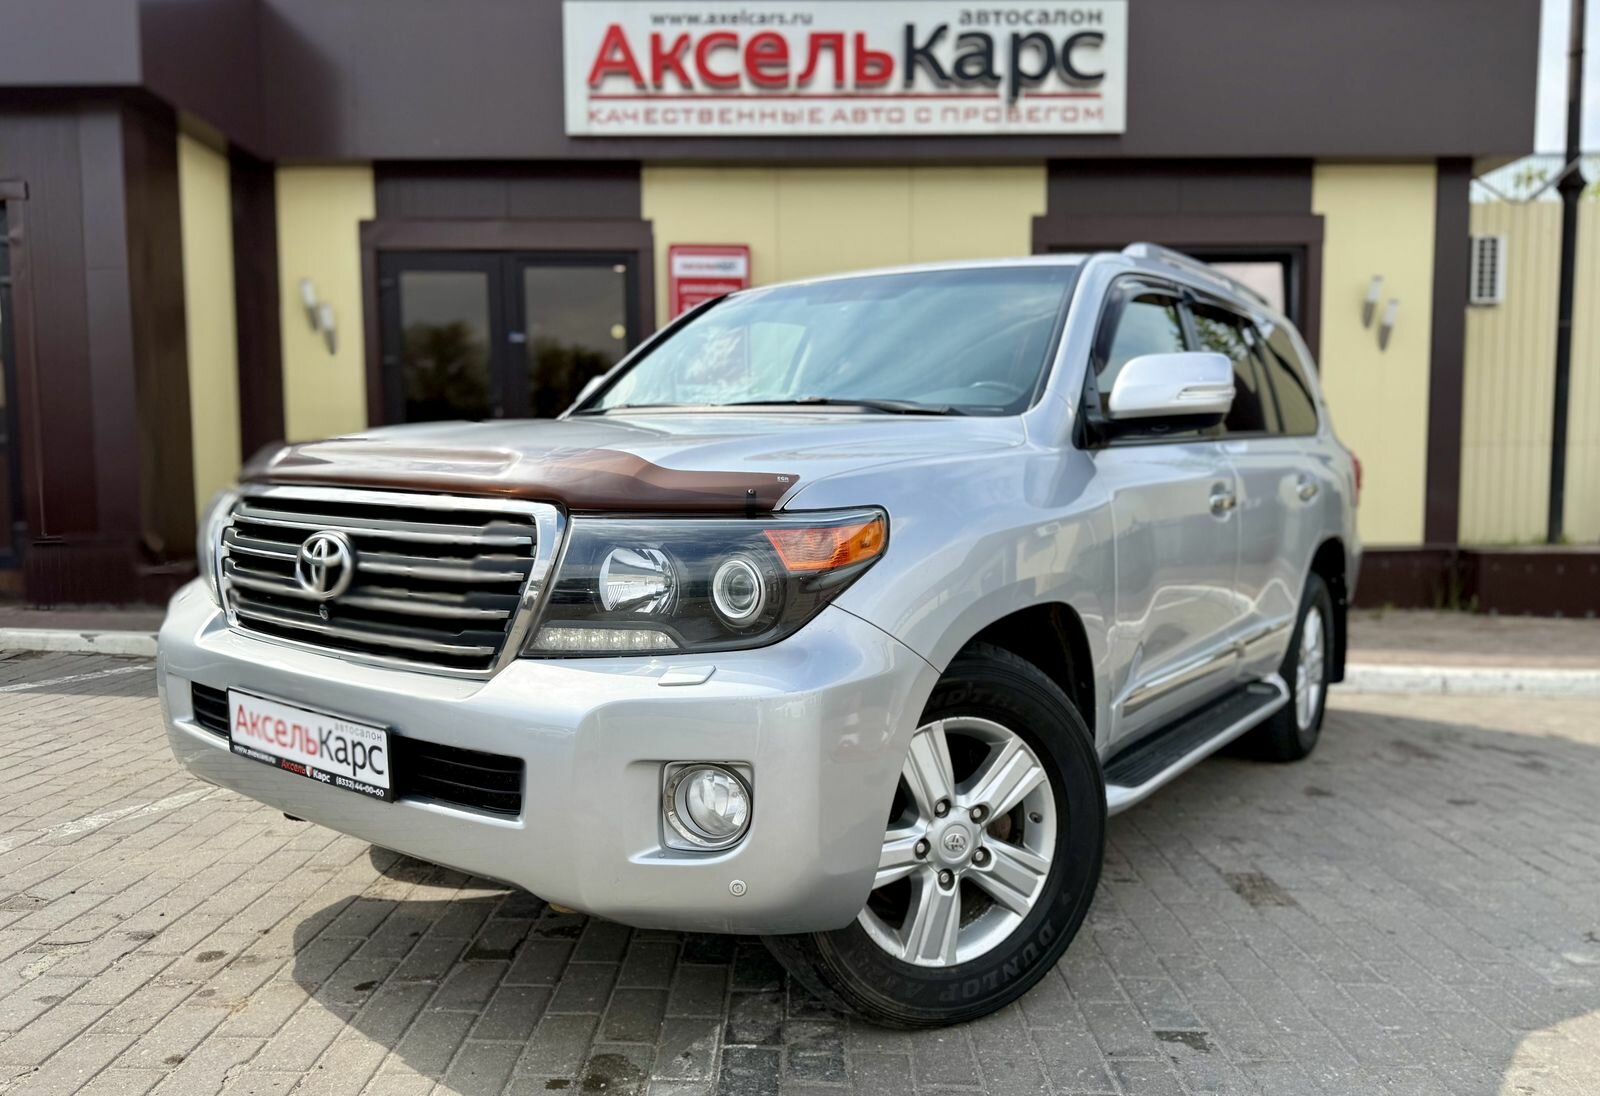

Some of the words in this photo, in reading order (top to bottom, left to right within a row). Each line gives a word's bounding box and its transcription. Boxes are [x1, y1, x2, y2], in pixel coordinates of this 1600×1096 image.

[651, 11, 813, 26] www.axelcars.ru
[959, 9, 1103, 26] автосалон
[587, 107, 825, 124] КАЧЕСТВЕННЫЕ
[831, 107, 905, 124] АВТО
[914, 107, 932, 124] С
[941, 106, 1104, 124] ПРОБЕГОМ
[335, 722, 382, 741] автосалон
[313, 769, 330, 783] Карс
[939, 919, 1058, 1002] DUNLOP
